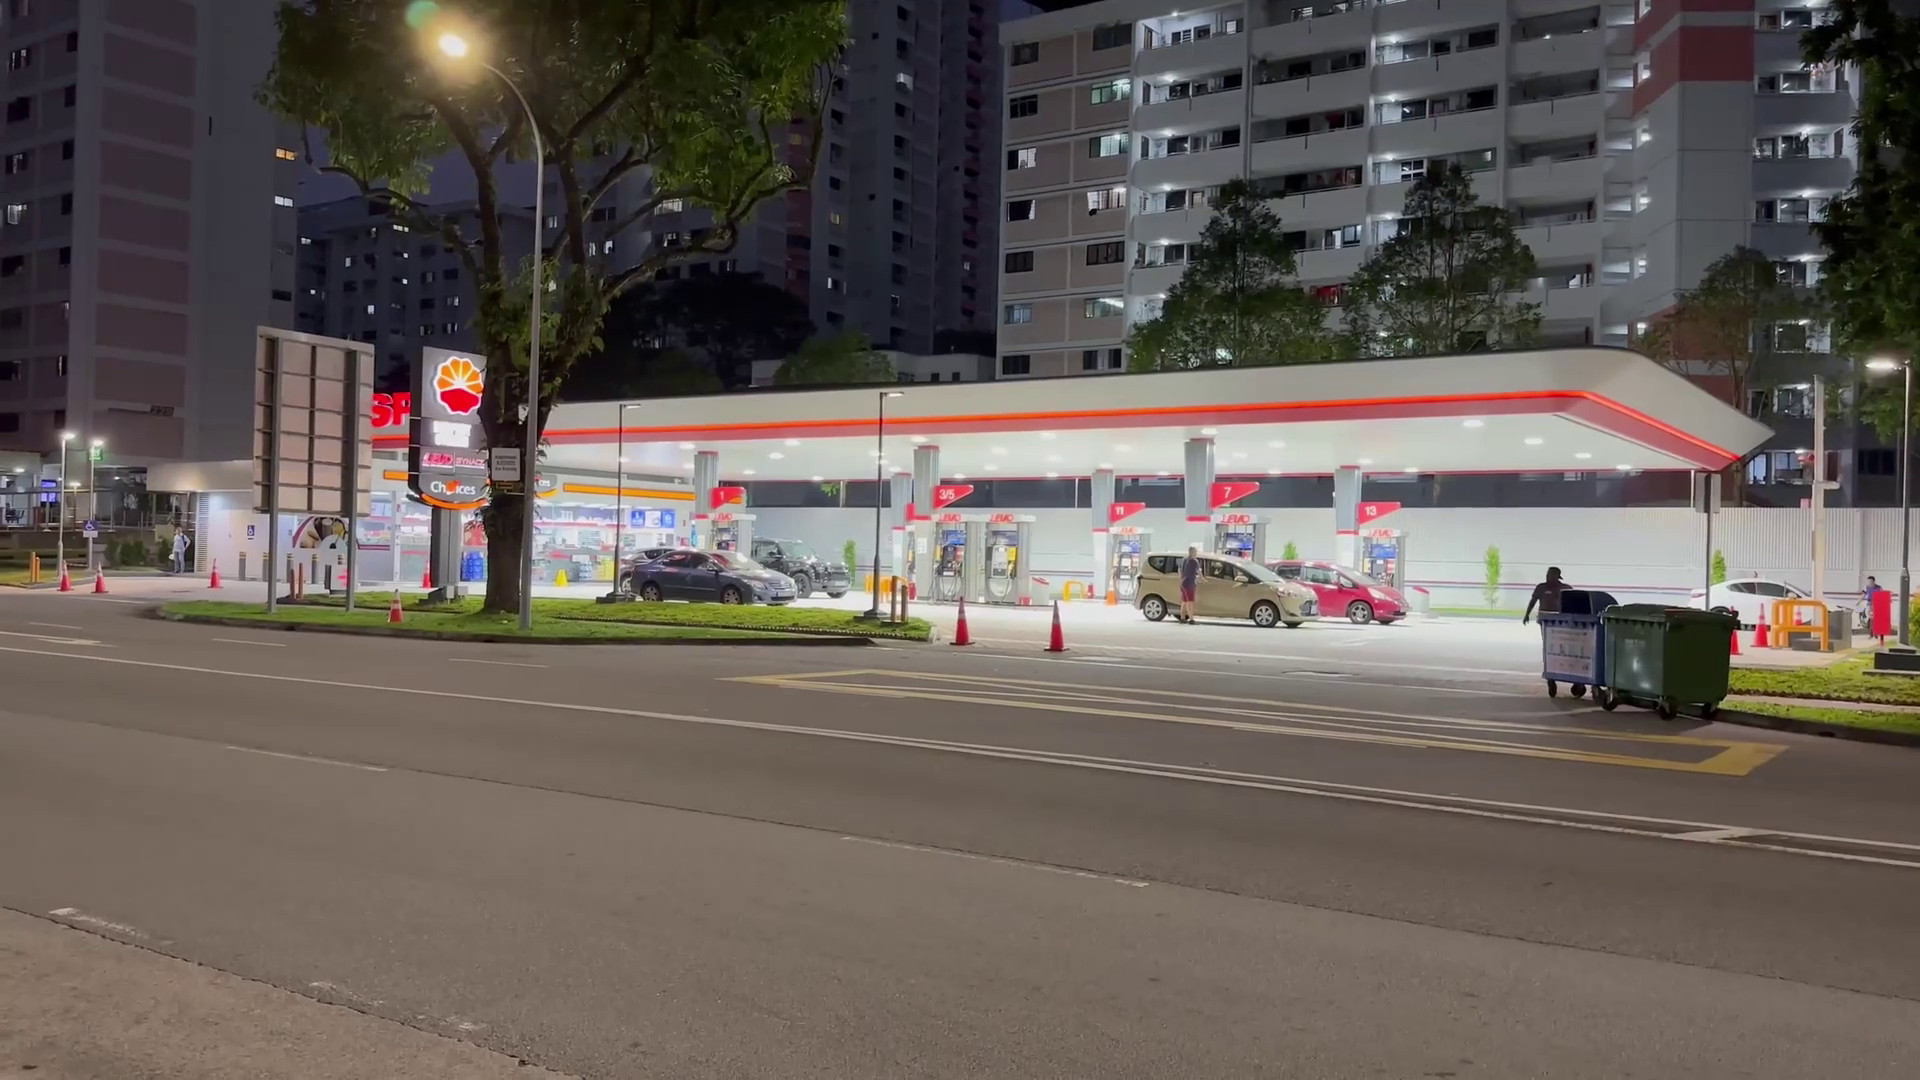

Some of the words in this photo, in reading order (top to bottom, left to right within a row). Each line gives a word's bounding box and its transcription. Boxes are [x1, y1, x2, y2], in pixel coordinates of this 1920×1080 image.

[431, 481, 476, 495] Choices
[1223, 486, 1233, 499] 7
[720, 490, 725, 500] 1
[939, 488, 955, 500] 3/5
[1114, 505, 1125, 515] 11
[1364, 505, 1377, 516] 13
[988, 513, 1015, 522] LEVO
[1220, 513, 1252, 523] LEVO
